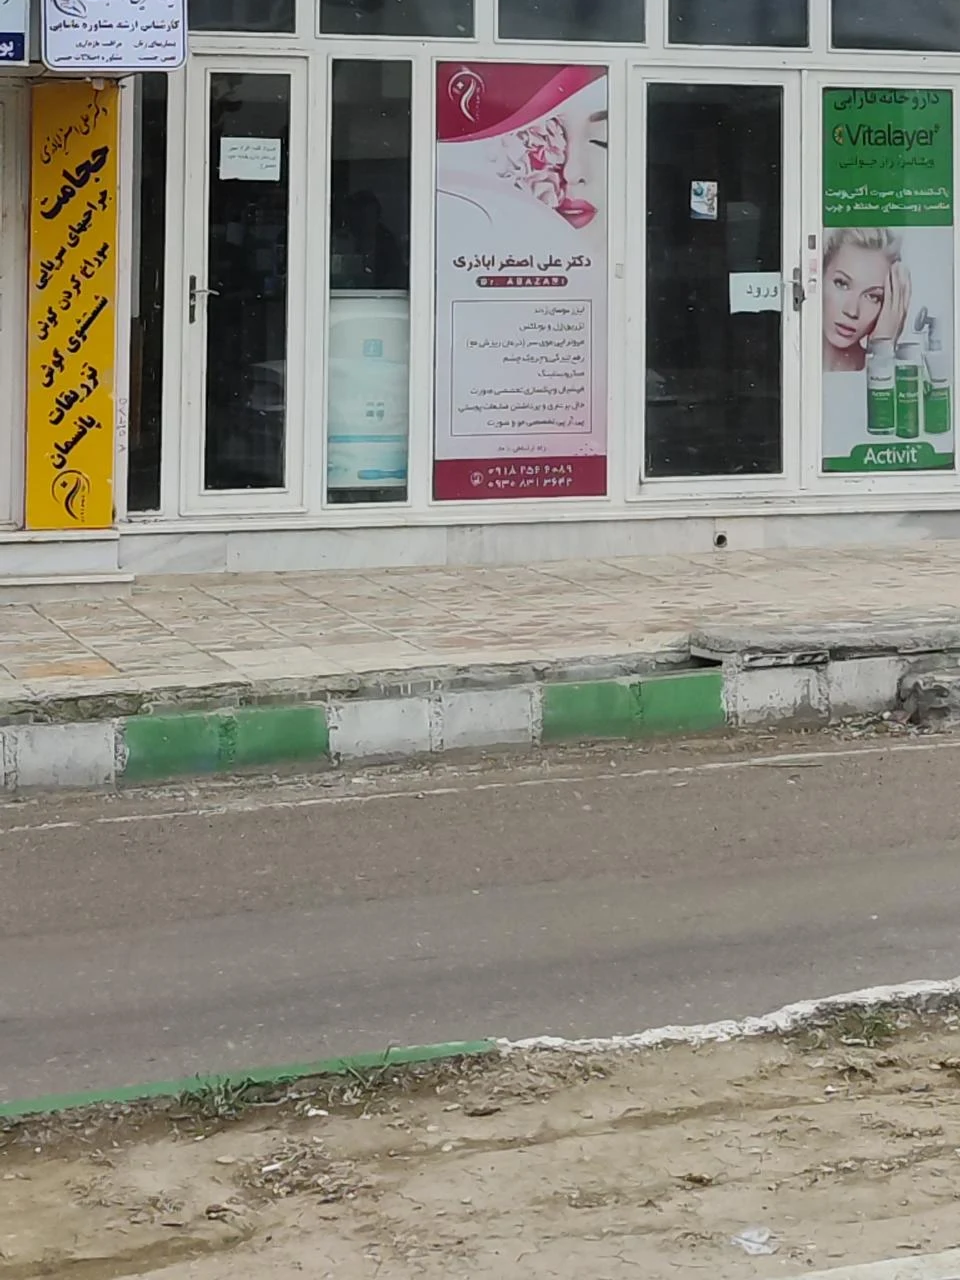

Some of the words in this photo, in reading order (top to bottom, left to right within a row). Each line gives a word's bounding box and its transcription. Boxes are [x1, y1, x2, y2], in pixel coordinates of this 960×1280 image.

[82, 21, 114, 32] مشاوره
[116, 21, 138, 32] ارشد
[141, 20, 180, 32] کارشناس
[834, 89, 877, 111] فارابی
[879, 89, 940, 110] داروخانه
[845, 123, 936, 151] Vitalayer
[40, 145, 110, 220] حجامت
[36, 245, 67, 290] سرپایی
[80, 241, 110, 279] سوراخ
[453, 254, 495, 272] اباذری
[498, 254, 534, 272] اصغر
[537, 254, 562, 272] علی
[565, 254, 592, 272] دکتر
[58, 273, 81, 311] کردن
[507, 276, 566, 287] ABAZARI
[747, 285, 778, 298] ورود
[67, 295, 109, 353] شستشوی
[41, 347, 65, 388] گوش
[49, 361, 99, 426] تزریقات
[51, 414, 102, 470] پانسمان
[863, 445, 918, 465] Activit
